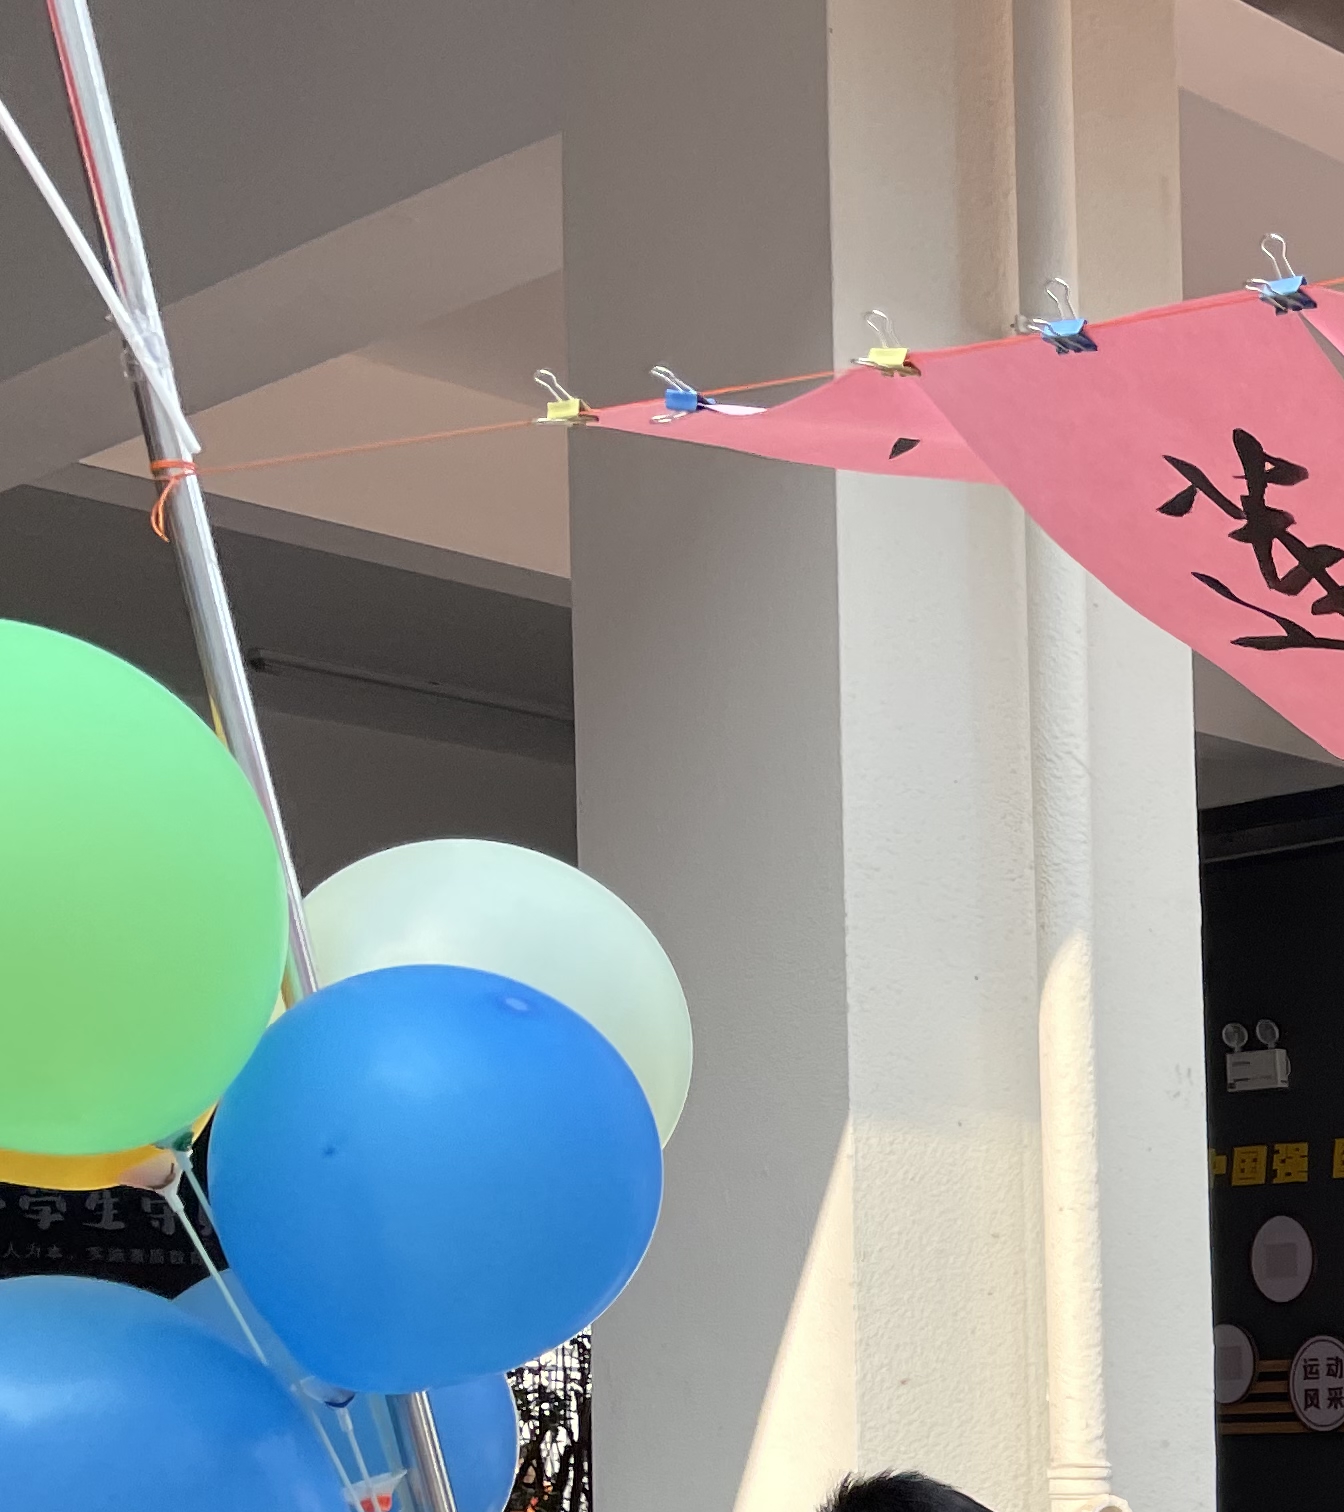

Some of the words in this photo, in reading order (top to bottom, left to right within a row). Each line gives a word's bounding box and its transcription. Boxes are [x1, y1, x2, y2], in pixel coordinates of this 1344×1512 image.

[0, 1189, 214, 1237] 学生守
[1303, 1356, 1344, 1380] 运动
[1304, 1387, 1344, 1411] 风采
